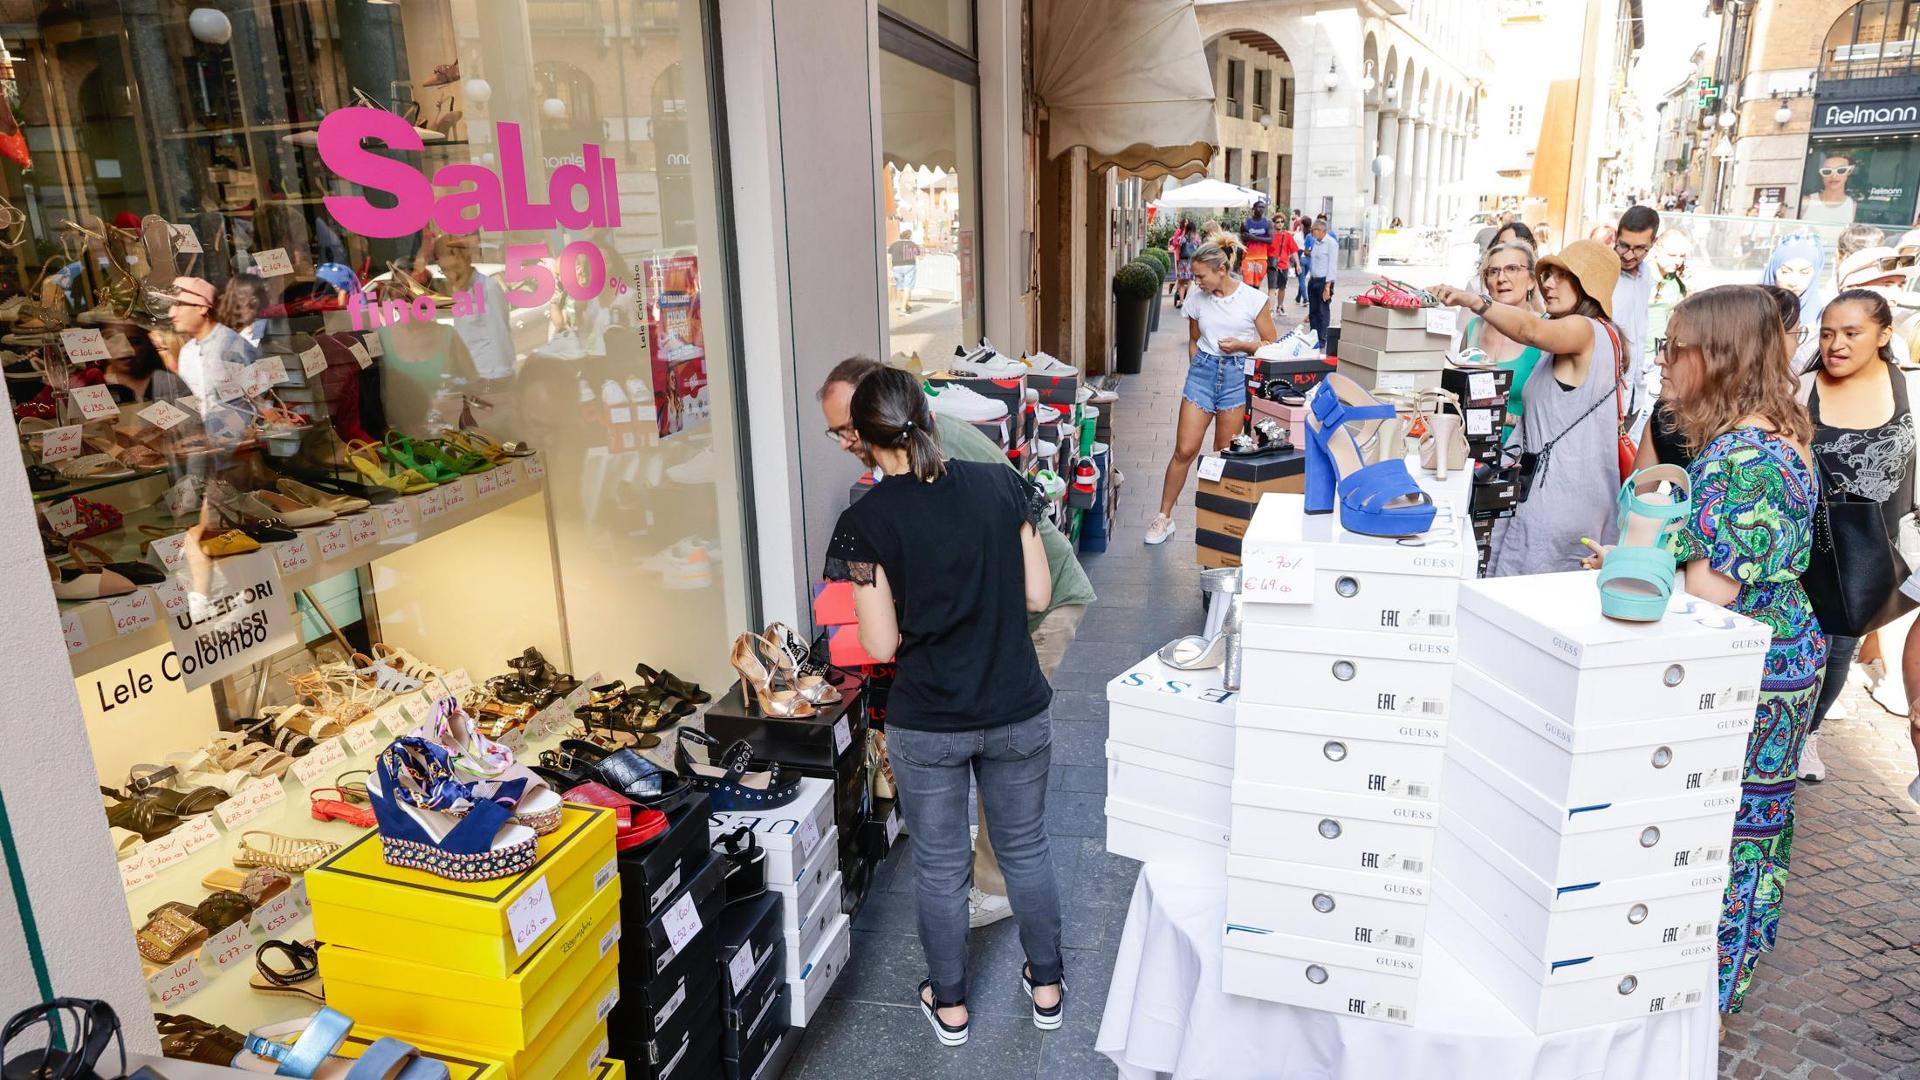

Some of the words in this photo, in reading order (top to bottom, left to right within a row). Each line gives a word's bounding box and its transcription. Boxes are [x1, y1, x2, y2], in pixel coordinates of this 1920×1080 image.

[634, 264, 644, 321] Colombo
[346, 288, 438, 332] fino
[451, 281, 486, 318] al
[1413, 557, 1455, 568] GUESS
[1381, 609, 1400, 628] EAC
[1408, 642, 1450, 655] GUESS
[1552, 636, 1579, 657] GUESS
[1731, 639, 1766, 650] GUESS
[96, 668, 154, 713] Lele
[161, 624, 267, 682] Colombo
[1377, 693, 1396, 711] EAC
[1699, 692, 1716, 710] EAC
[1717, 717, 1749, 729] GUESS
[1399, 726, 1440, 739] GUESS
[1545, 722, 1571, 743] GUESS
[1368, 774, 1386, 791] EAC
[1687, 772, 1703, 790] EAC
[1704, 796, 1736, 808] GUESS
[1393, 807, 1433, 820] GUESS
[1362, 852, 1380, 869] EAC
[1674, 851, 1691, 867] EAC
[1691, 874, 1723, 887] GUESS
[1384, 883, 1423, 896] GUESS
[1355, 926, 1373, 943] EAC
[1663, 927, 1679, 943] EAC
[1681, 944, 1712, 957] GUESS
[1375, 956, 1414, 969] GUESS
[1349, 998, 1366, 1014] EAC
[1650, 997, 1665, 1013] EAC
